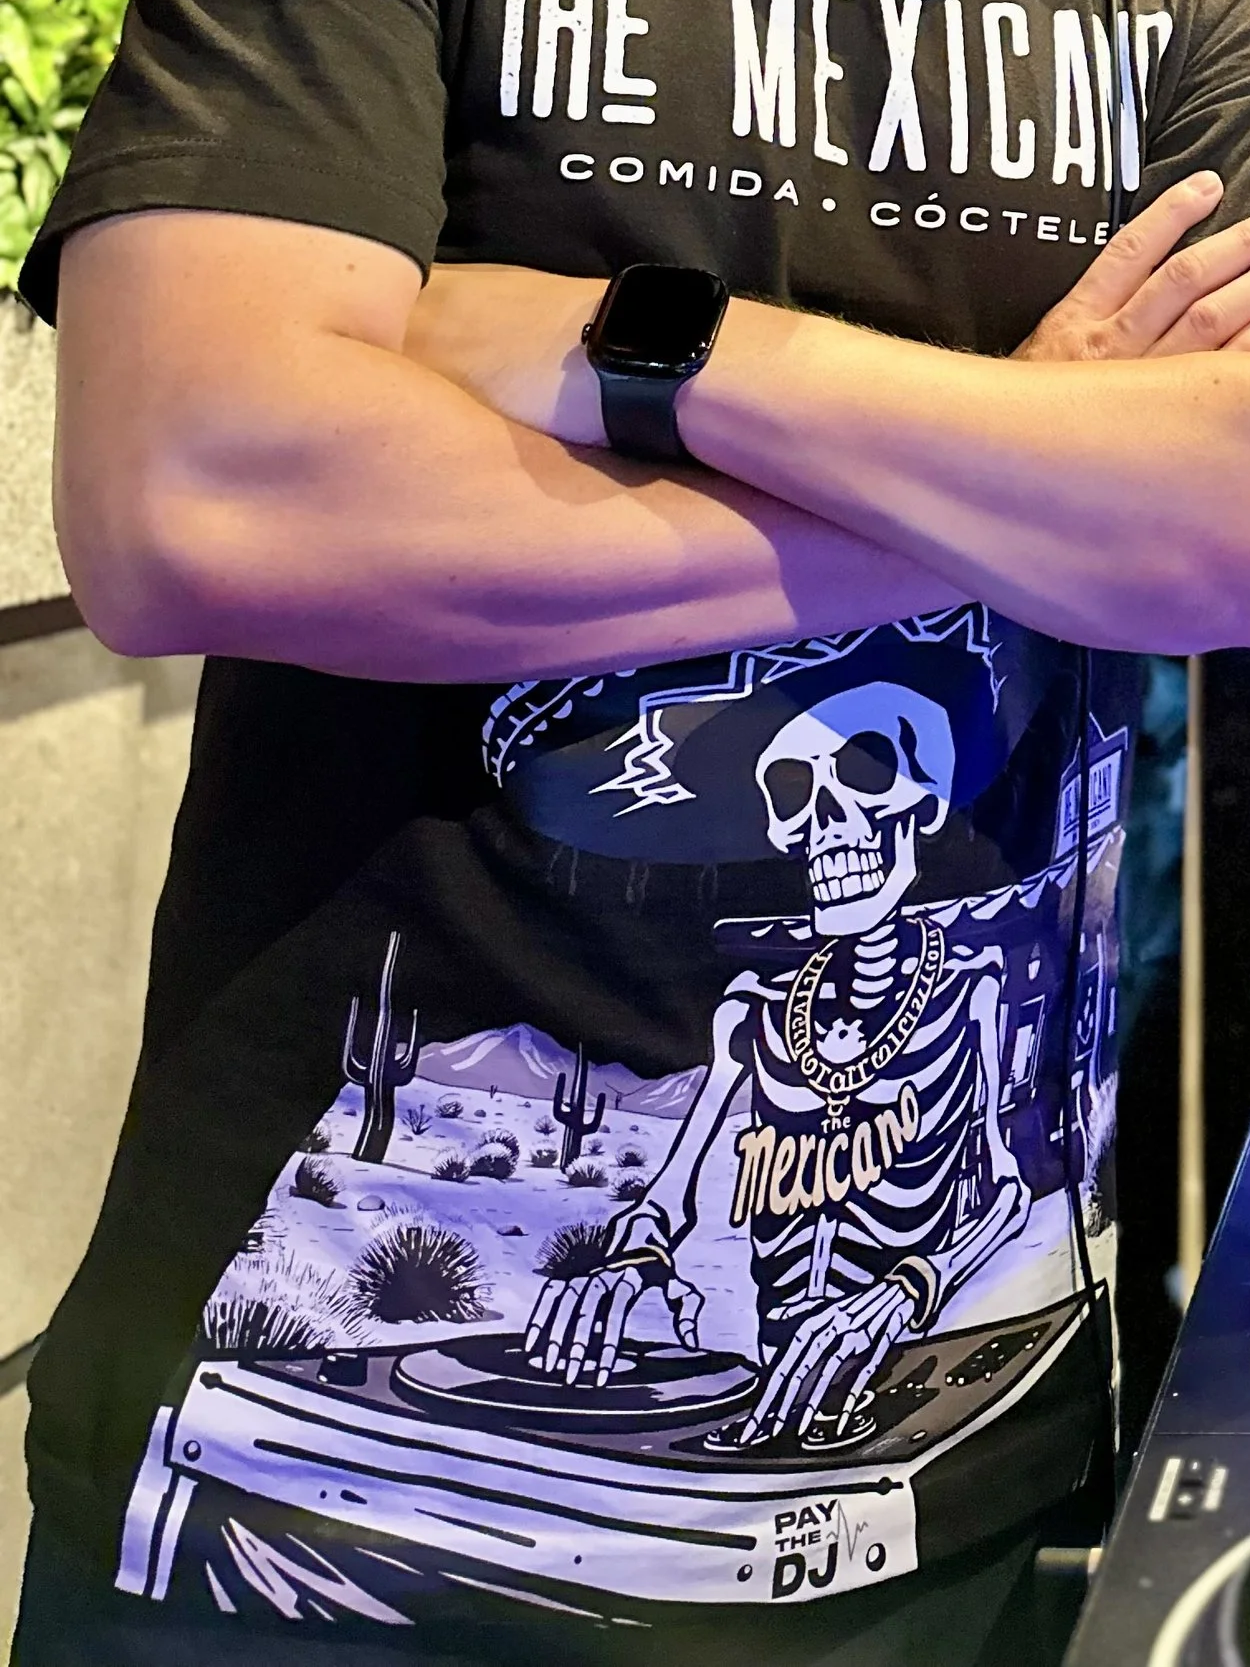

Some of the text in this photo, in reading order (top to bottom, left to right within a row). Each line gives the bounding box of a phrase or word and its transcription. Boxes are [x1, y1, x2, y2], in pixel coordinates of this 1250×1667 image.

[560, 153, 1126, 246] COMIDA CÓCTELE
[774, 1498, 838, 1535] PAY
[774, 1530, 821, 1552] THE
[771, 1541, 838, 1600] DJ
